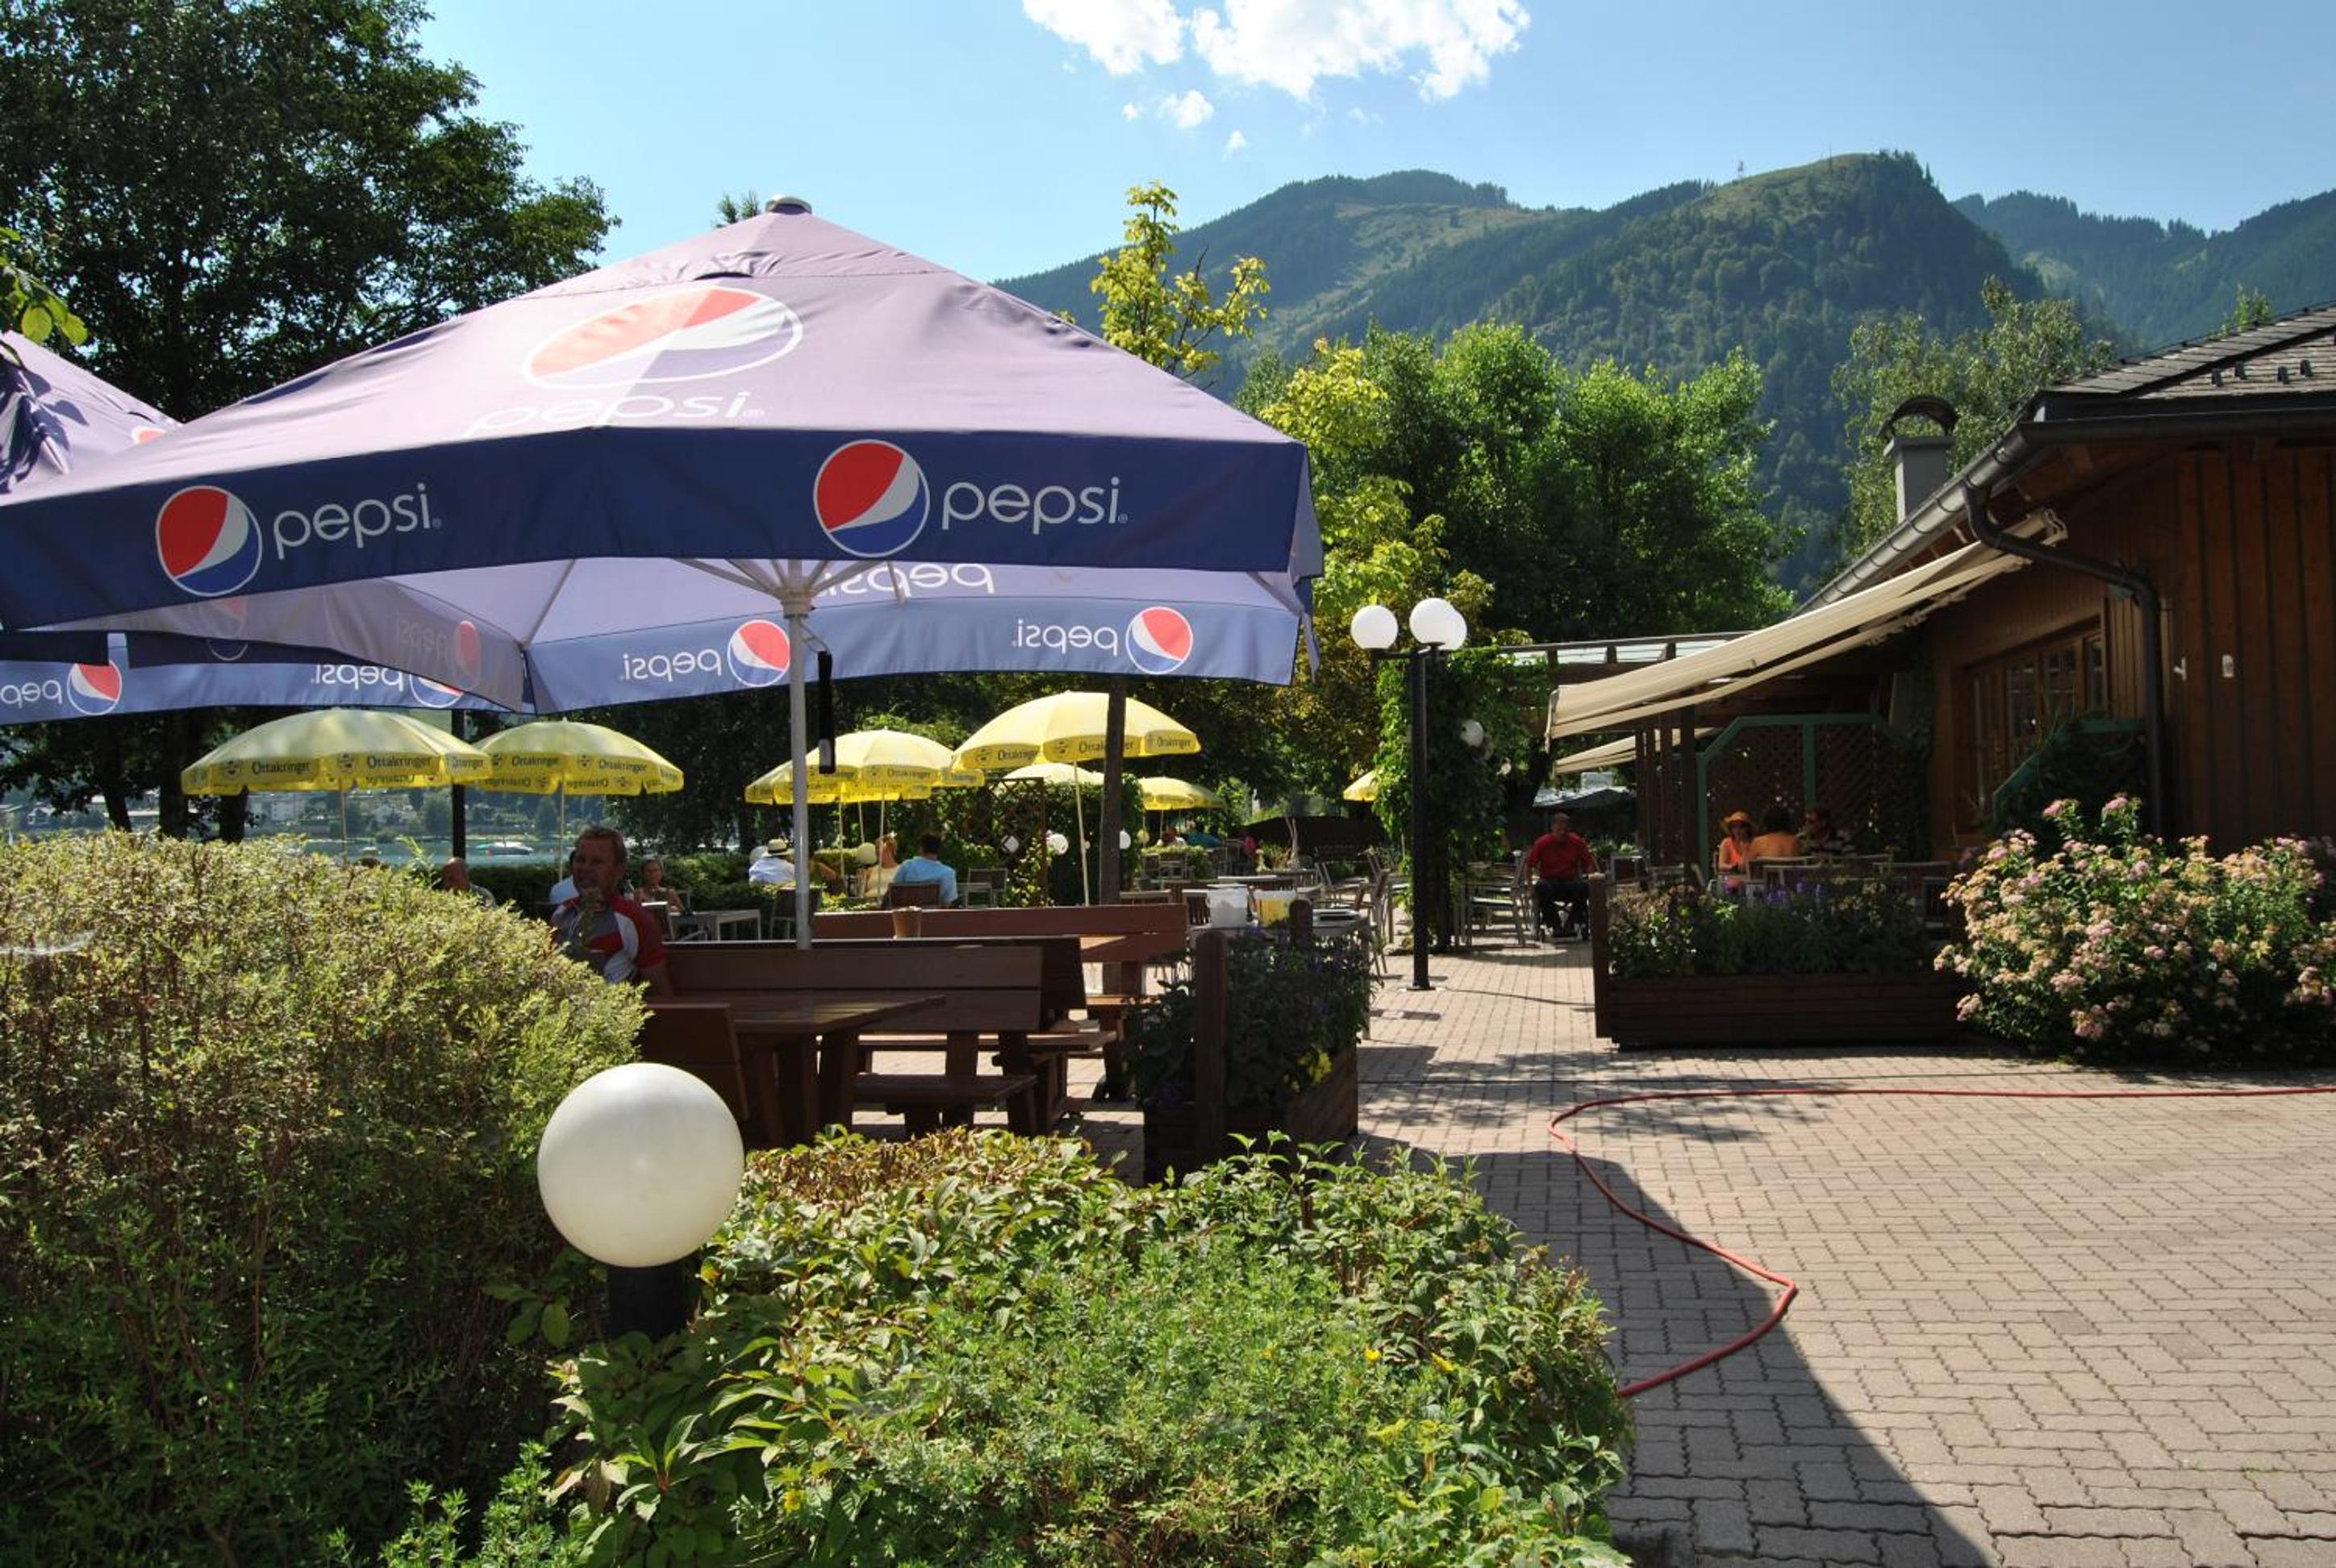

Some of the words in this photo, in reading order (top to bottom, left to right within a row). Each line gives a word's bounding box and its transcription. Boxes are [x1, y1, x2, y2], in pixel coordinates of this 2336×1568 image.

[461, 392, 751, 439] pepsi
[273, 482, 430, 560] pepsi
[941, 476, 1120, 535] pepsi
[1078, 740, 1134, 754] Ottaker
